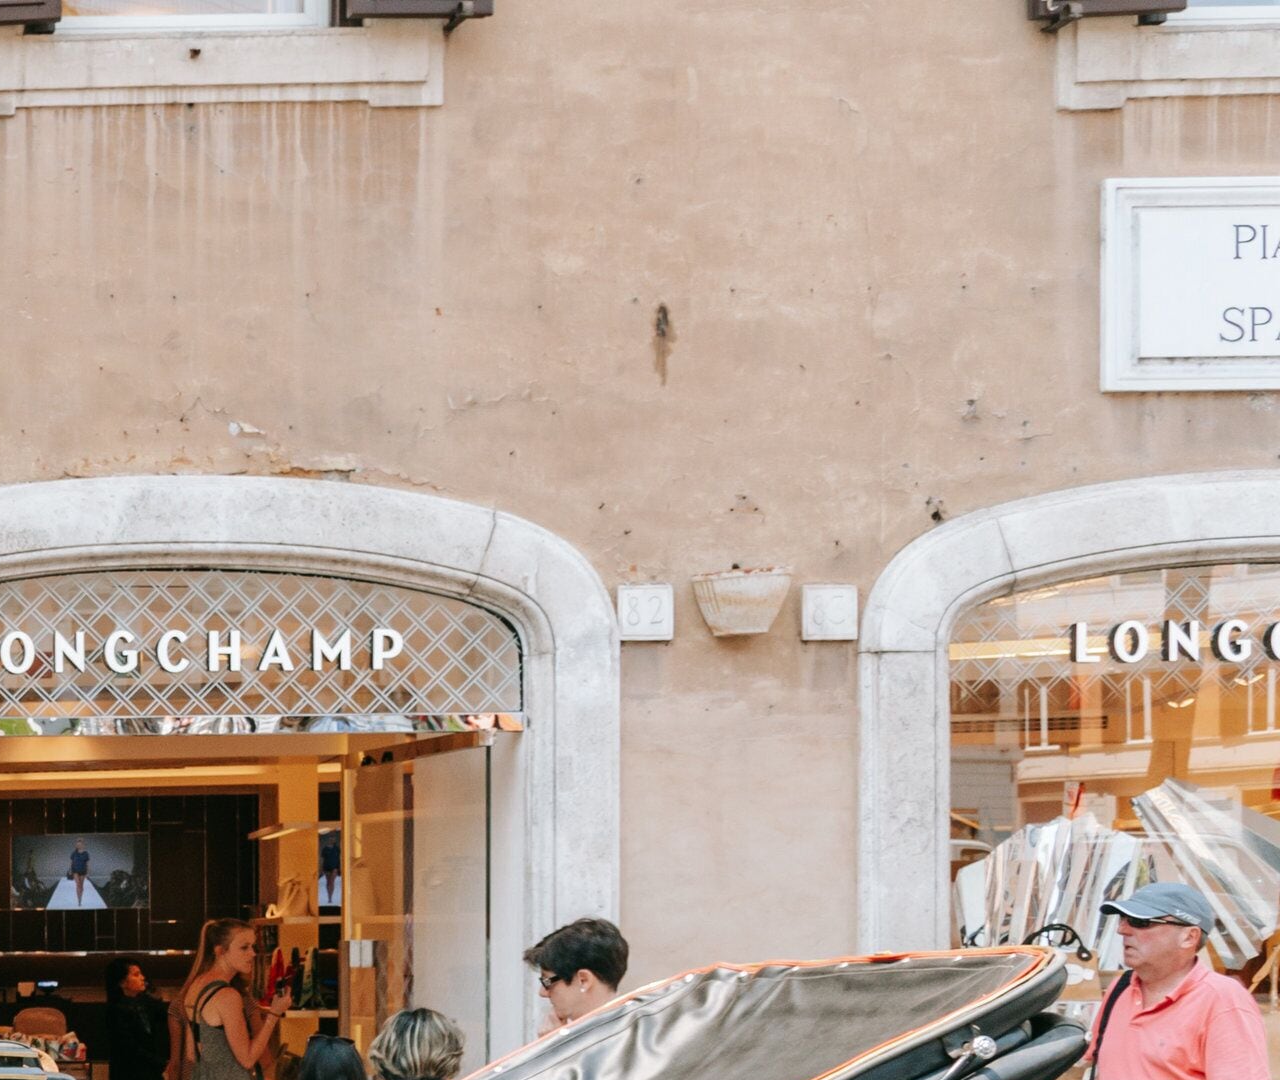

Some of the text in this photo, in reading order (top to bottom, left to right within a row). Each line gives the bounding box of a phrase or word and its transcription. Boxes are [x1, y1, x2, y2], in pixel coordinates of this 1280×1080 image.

[1231, 223, 1280, 261] PI
[1218, 306, 1280, 343] SP
[626, 595, 665, 627] 82
